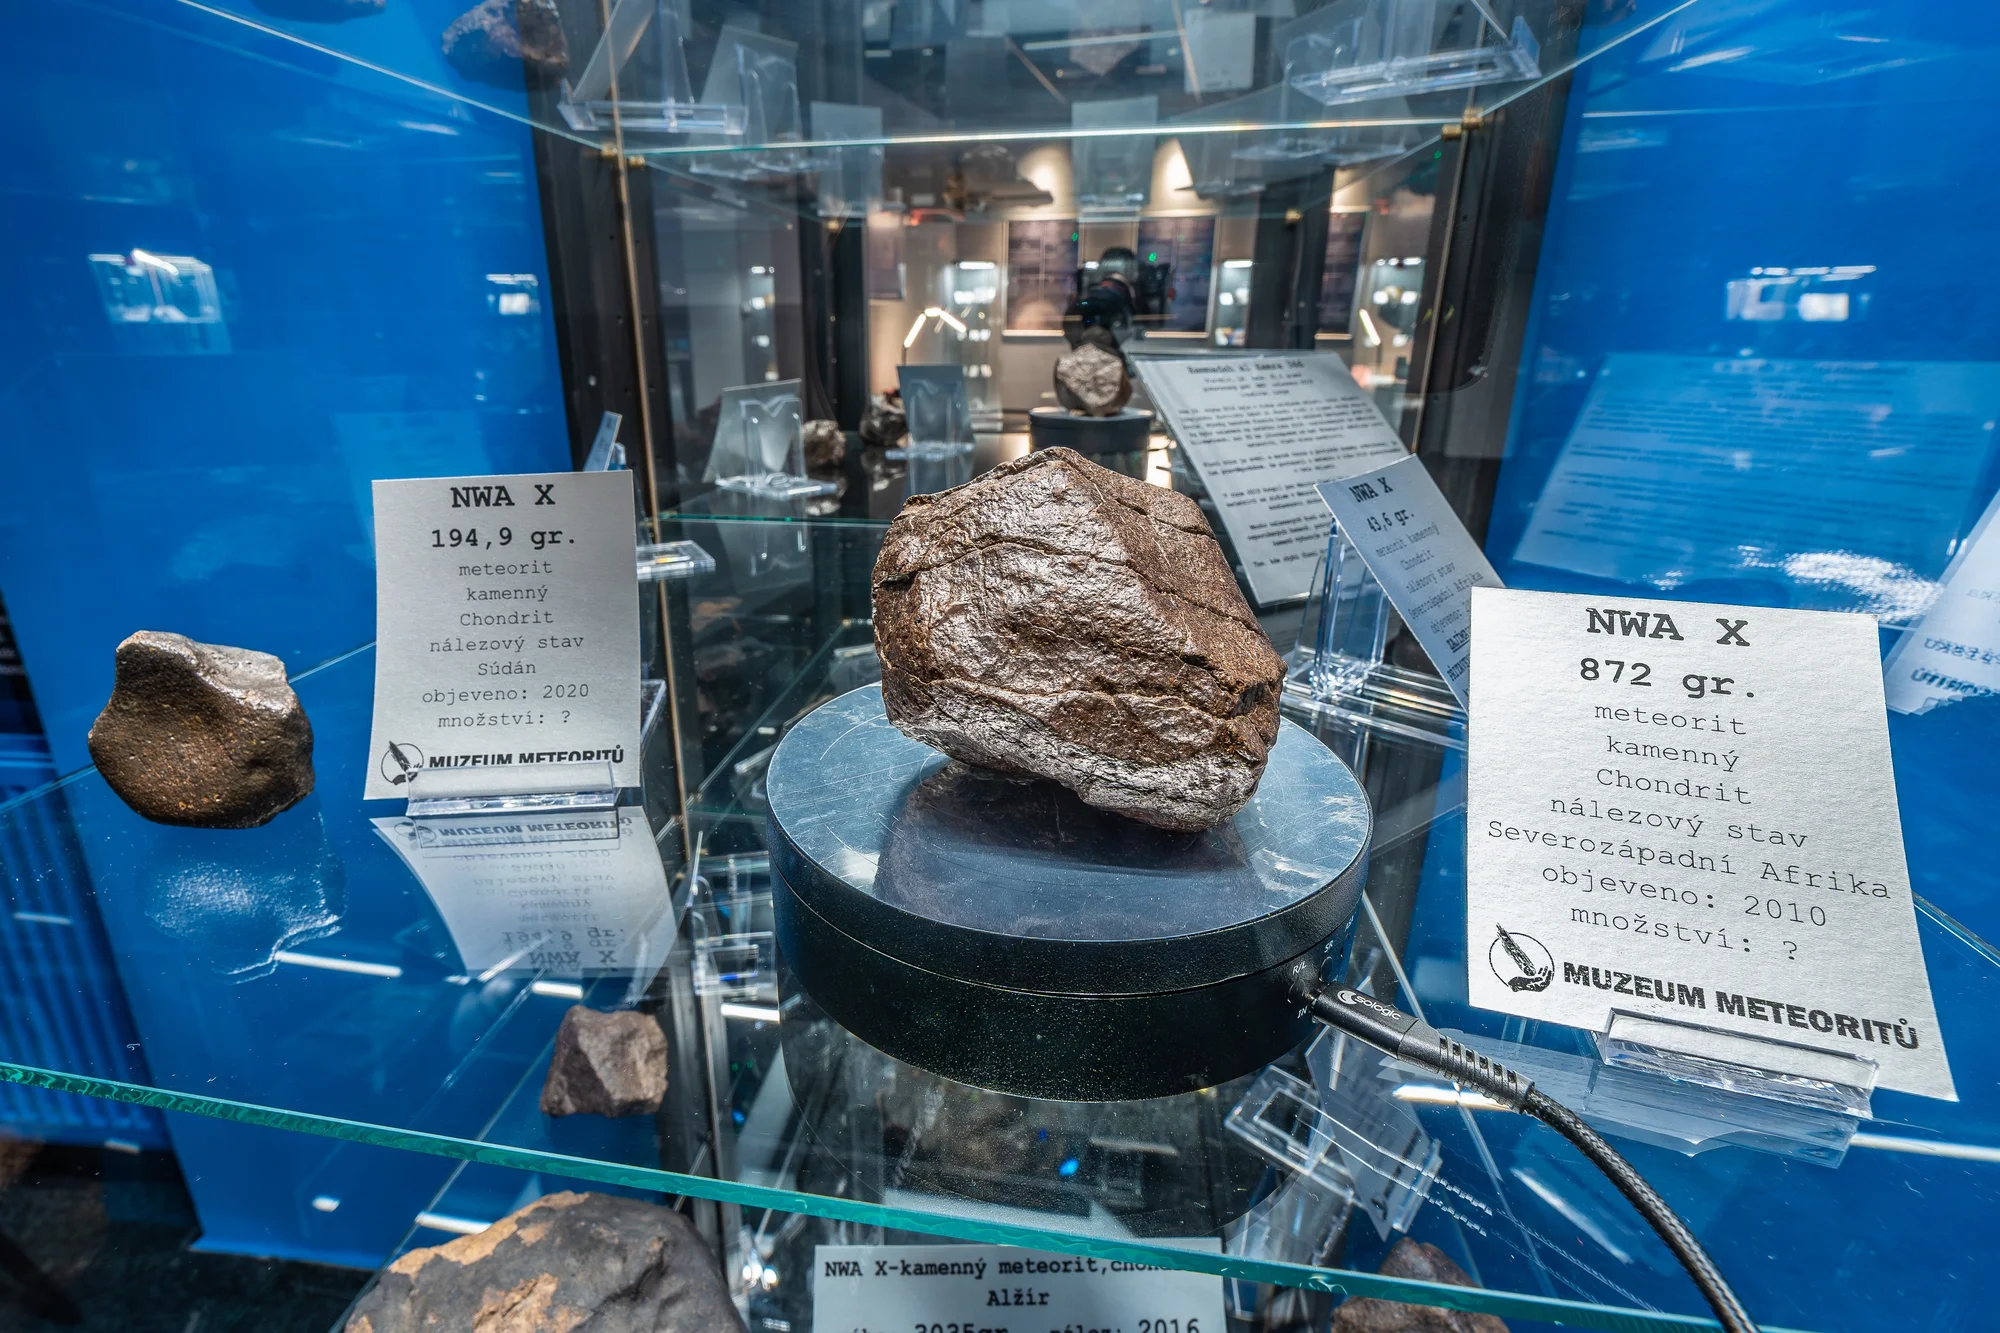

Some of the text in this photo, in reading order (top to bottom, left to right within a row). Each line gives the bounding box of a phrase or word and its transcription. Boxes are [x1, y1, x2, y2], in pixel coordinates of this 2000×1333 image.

[451, 484, 556, 508] NWA X
[1349, 483, 1379, 503] NWA
[1377, 477, 1393, 493] X
[1366, 509, 1415, 532] 43,6 gr.
[431, 527, 575, 550] 194,9 gr.
[459, 560, 553, 576] meteorit
[1437, 562, 1456, 578] stav
[1452, 571, 1484, 592] Afrika
[466, 585, 549, 602] kamenný
[460, 610, 554, 626] Chondrit
[1586, 608, 1751, 647] NWA X
[430, 636, 584, 652] nálezový stav
[478, 662, 537, 676] Súdán
[1580, 657, 1757, 701] 872 gr.
[422, 683, 589, 705] objeveno: 2020
[438, 710, 571, 728] množství: ?
[1594, 704, 1748, 736] meteorit
[429, 744, 624, 768] MUZEUM METEORITŮ
[1607, 736, 1740, 773] kamenný
[1597, 769, 1752, 805] Chondrit
[1551, 797, 1808, 849] nálezový stav
[1488, 821, 1892, 900] Severozápadní Afrika
[1542, 866, 1827, 928] objeveno: 2010
[1571, 905, 1799, 961] množství: ?
[1563, 961, 1920, 1050] MUZEUM METEORITŮ
[824, 1261, 863, 1277] NWA
[874, 1258, 988, 1280] X-kamenný
[986, 1287, 1051, 1307] Alžír
[1137, 1318, 1201, 1333] 2016
